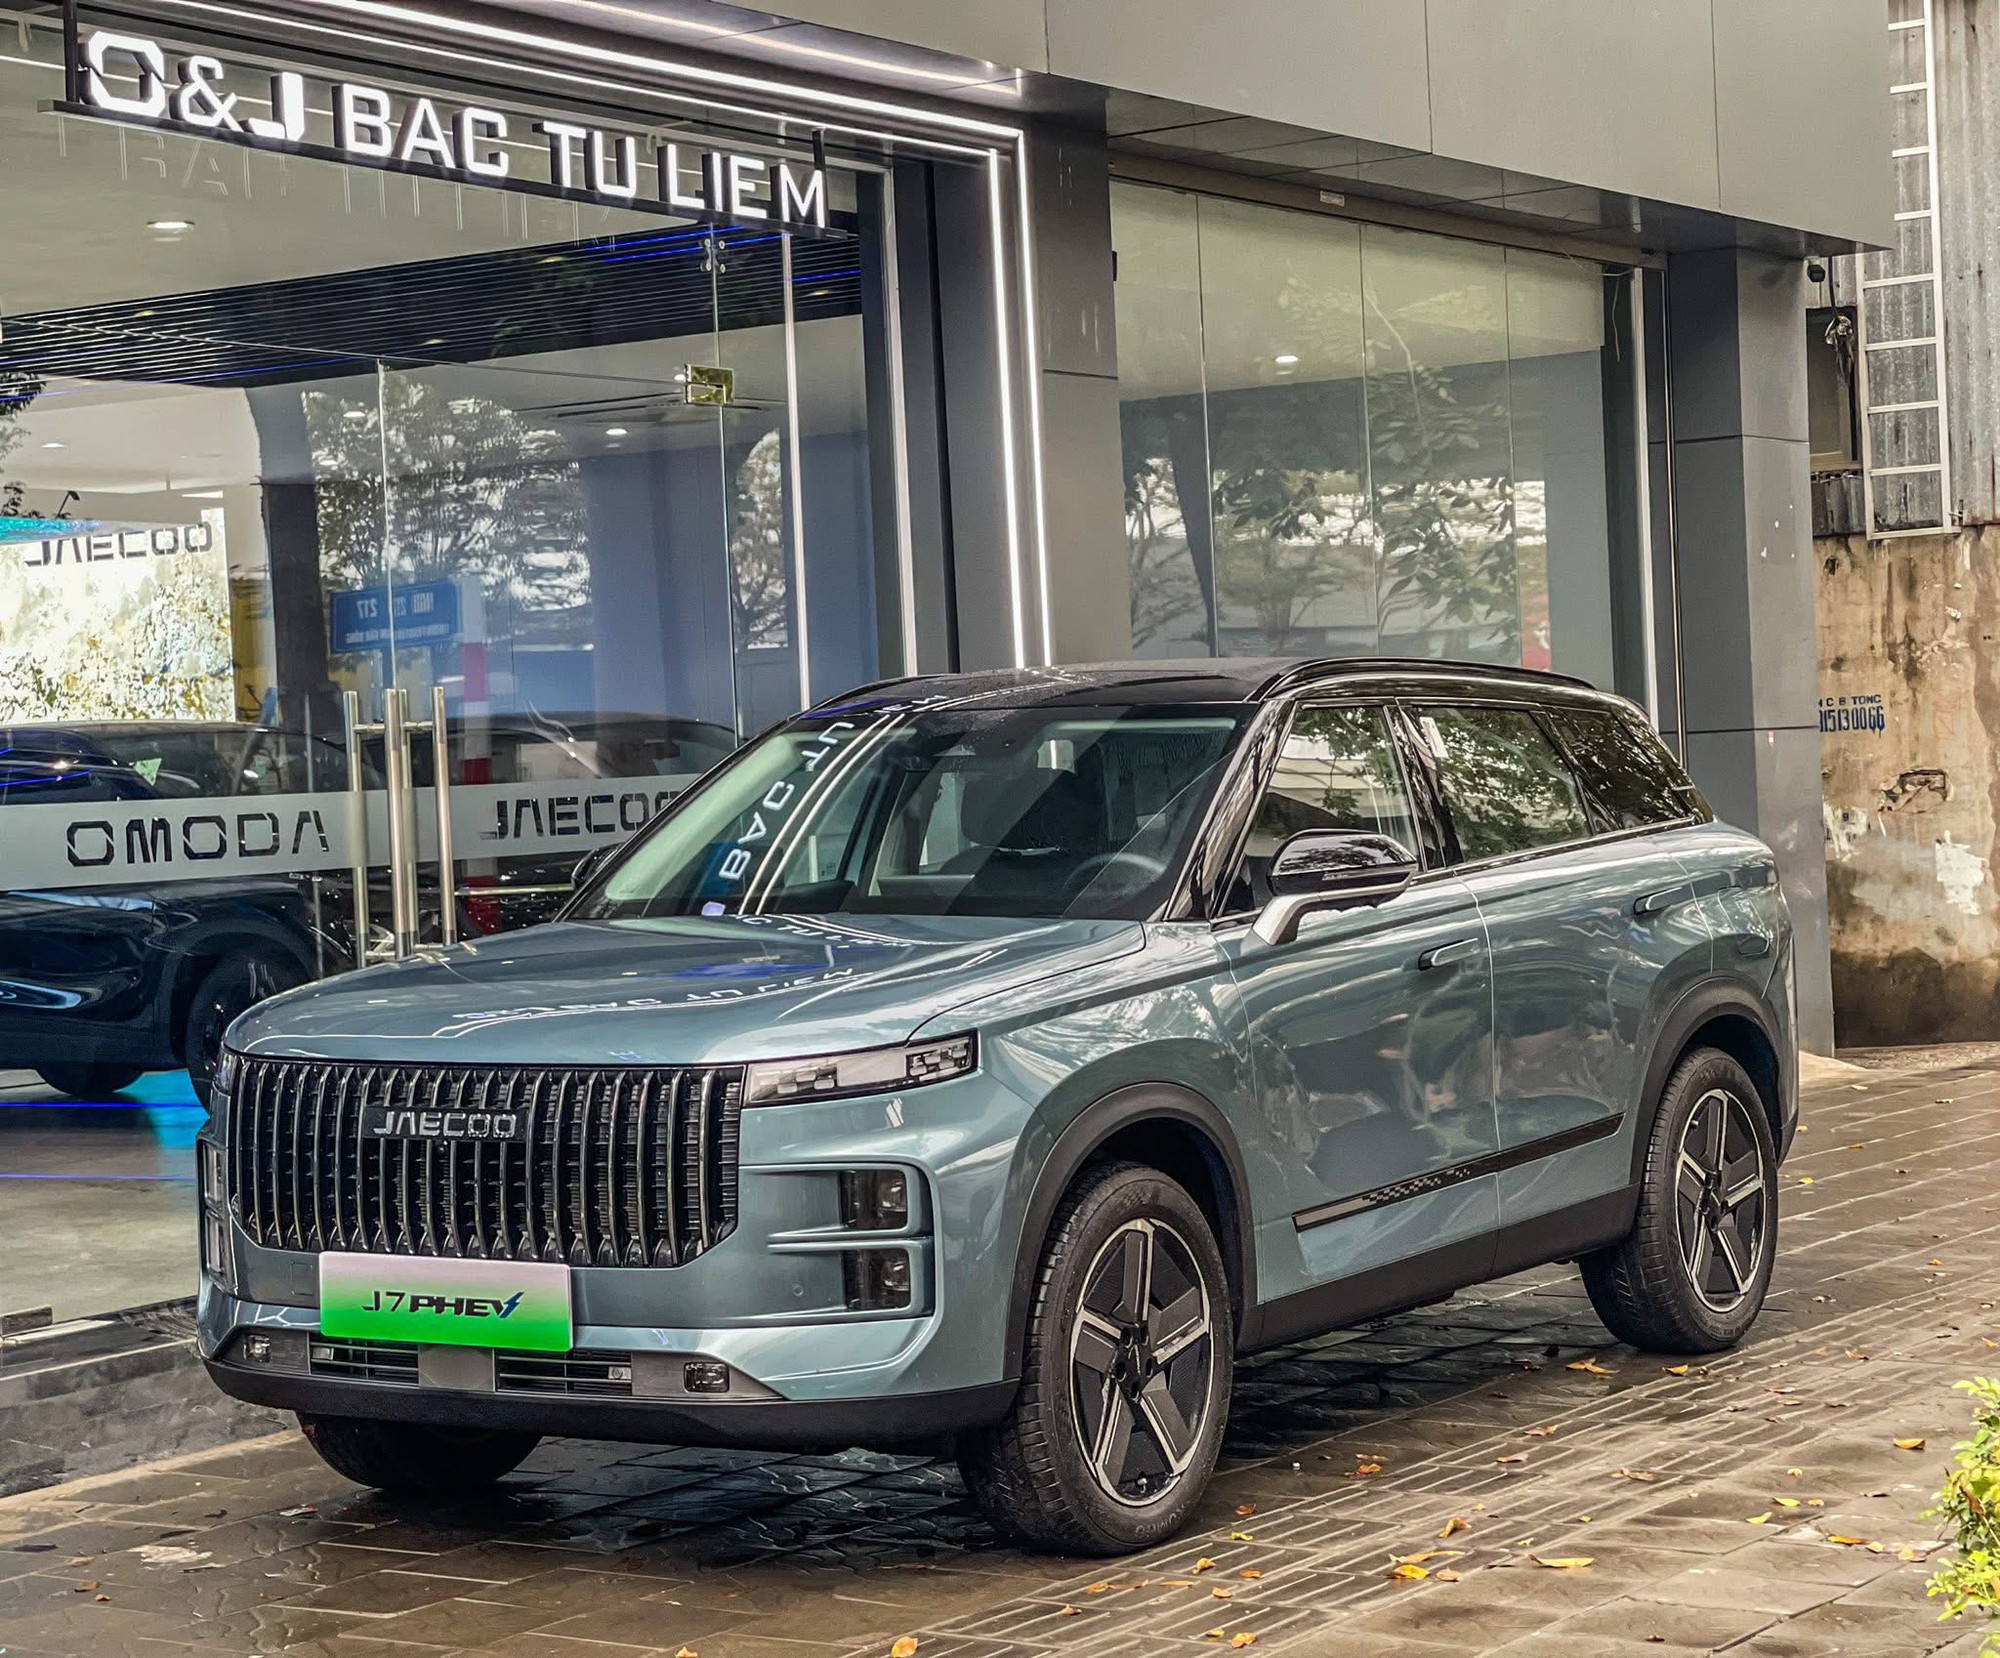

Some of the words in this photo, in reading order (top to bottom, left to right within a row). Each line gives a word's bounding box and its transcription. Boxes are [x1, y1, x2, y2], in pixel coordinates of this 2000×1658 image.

[78, 30, 304, 142] O&J
[332, 83, 509, 176] BAC
[532, 121, 637, 198] TU
[657, 143, 825, 228] LIEM
[24, 521, 212, 567] JAECOO
[66, 810, 330, 867] OMODA
[373, 1110, 517, 1138] JAECOO
